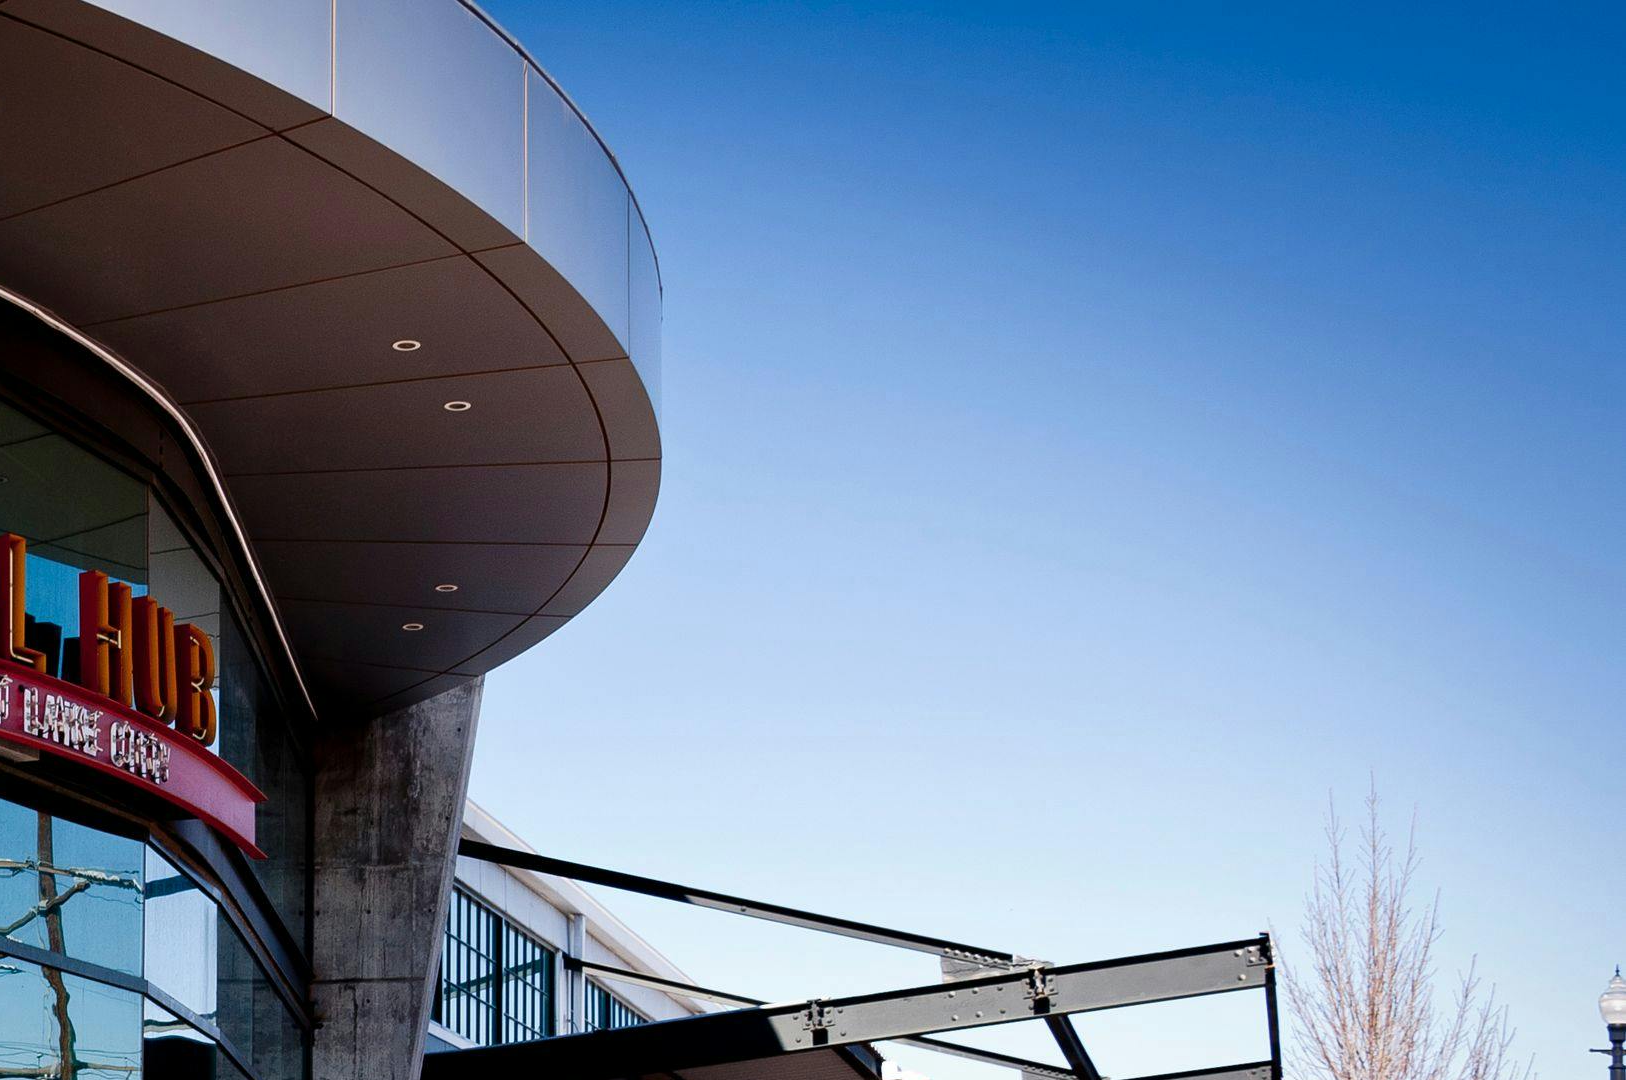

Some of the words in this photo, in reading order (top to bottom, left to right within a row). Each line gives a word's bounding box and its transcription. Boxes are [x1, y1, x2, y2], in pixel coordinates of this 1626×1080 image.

[78, 569, 217, 747] HUB
[24, 687, 104, 757] LAKE
[110, 721, 171, 784] CITY
